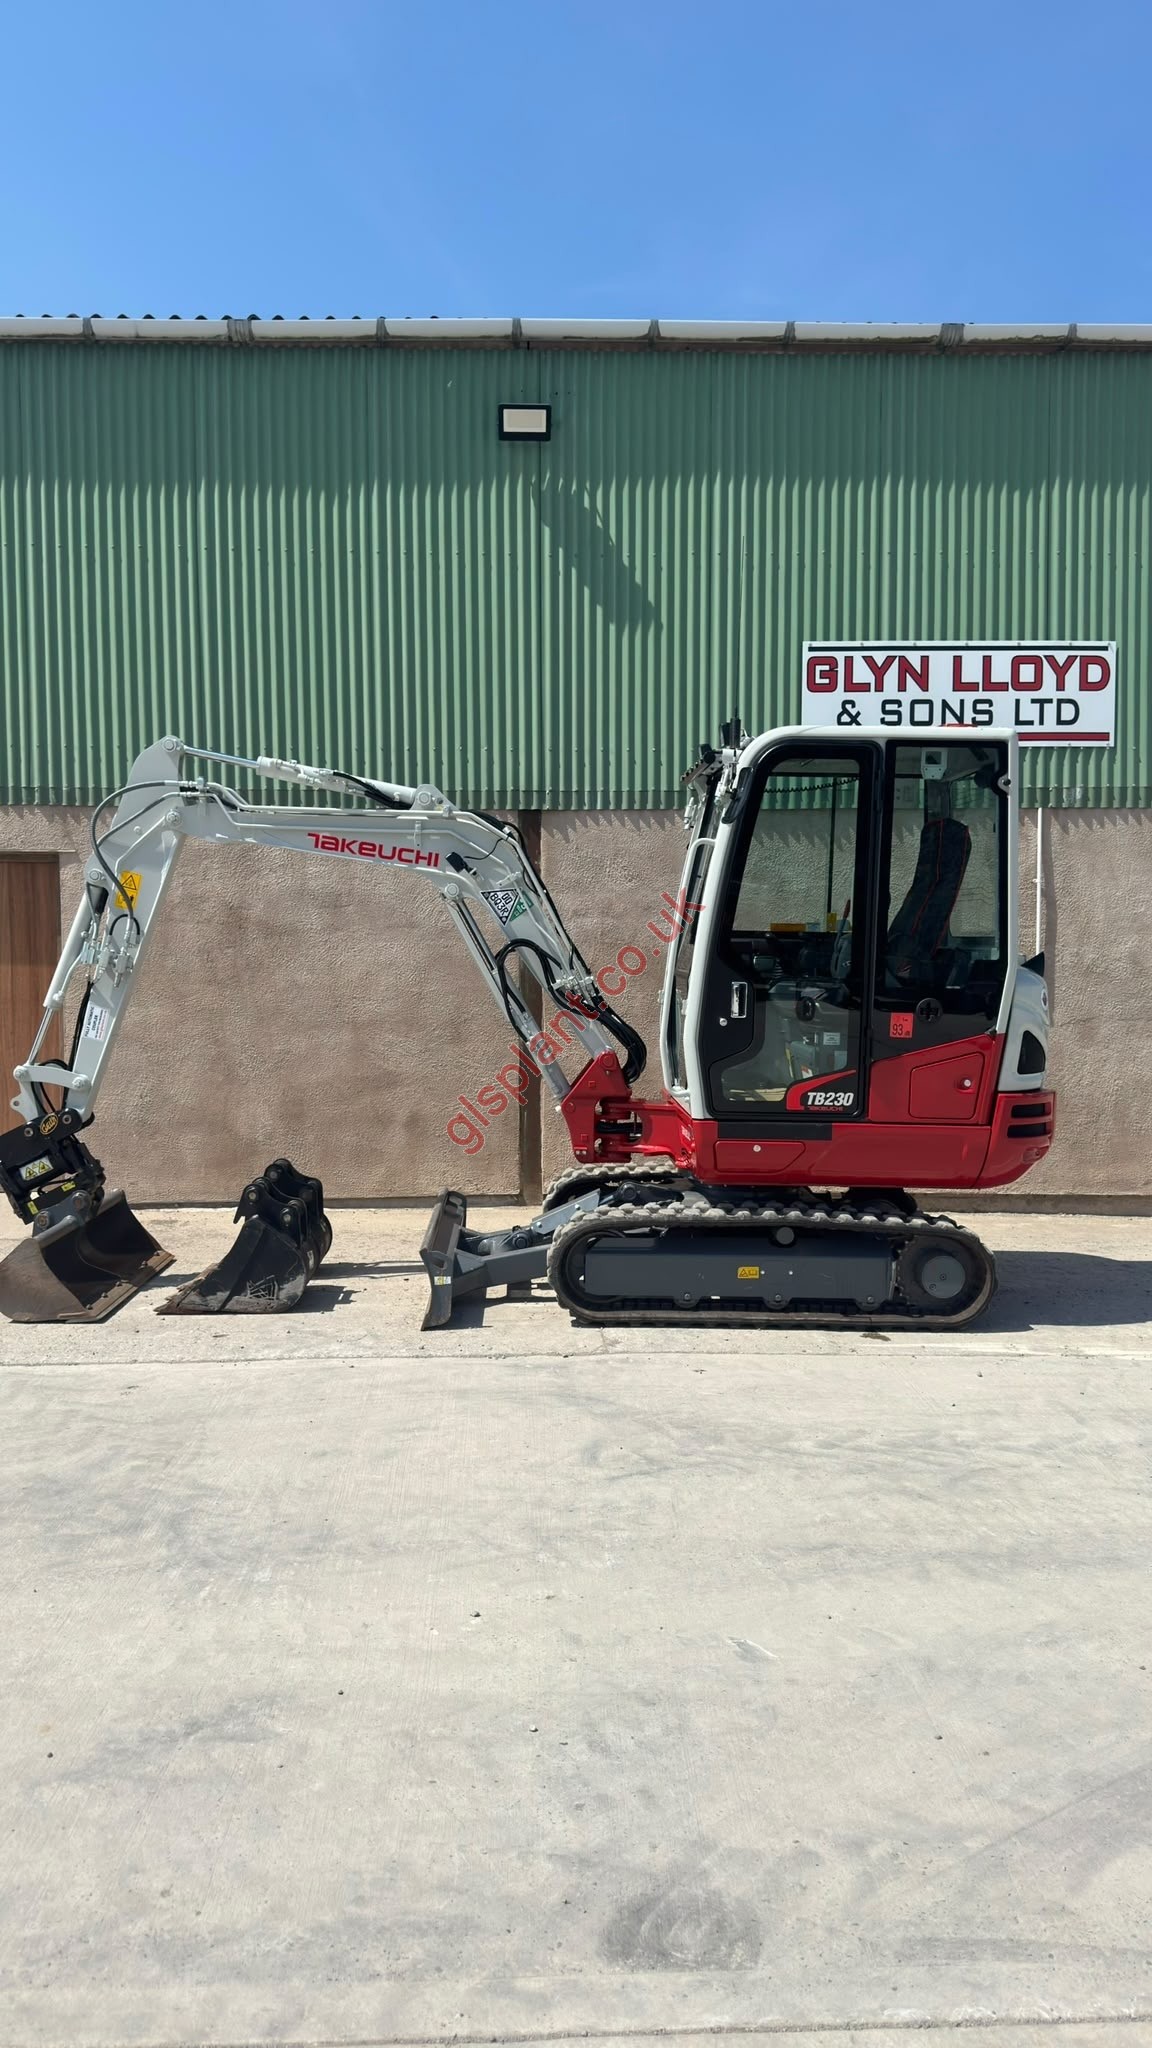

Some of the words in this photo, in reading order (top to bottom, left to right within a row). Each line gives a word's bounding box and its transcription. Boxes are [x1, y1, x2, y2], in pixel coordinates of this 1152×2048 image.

[806, 655, 930, 693] GLYN
[952, 655, 1111, 692] LLOYD
[836, 698, 862, 726] &
[880, 698, 994, 726] SONS
[1014, 698, 1080, 726] LTD
[892, 1023, 904, 1036] 93
[807, 1092, 855, 1106] TB230
